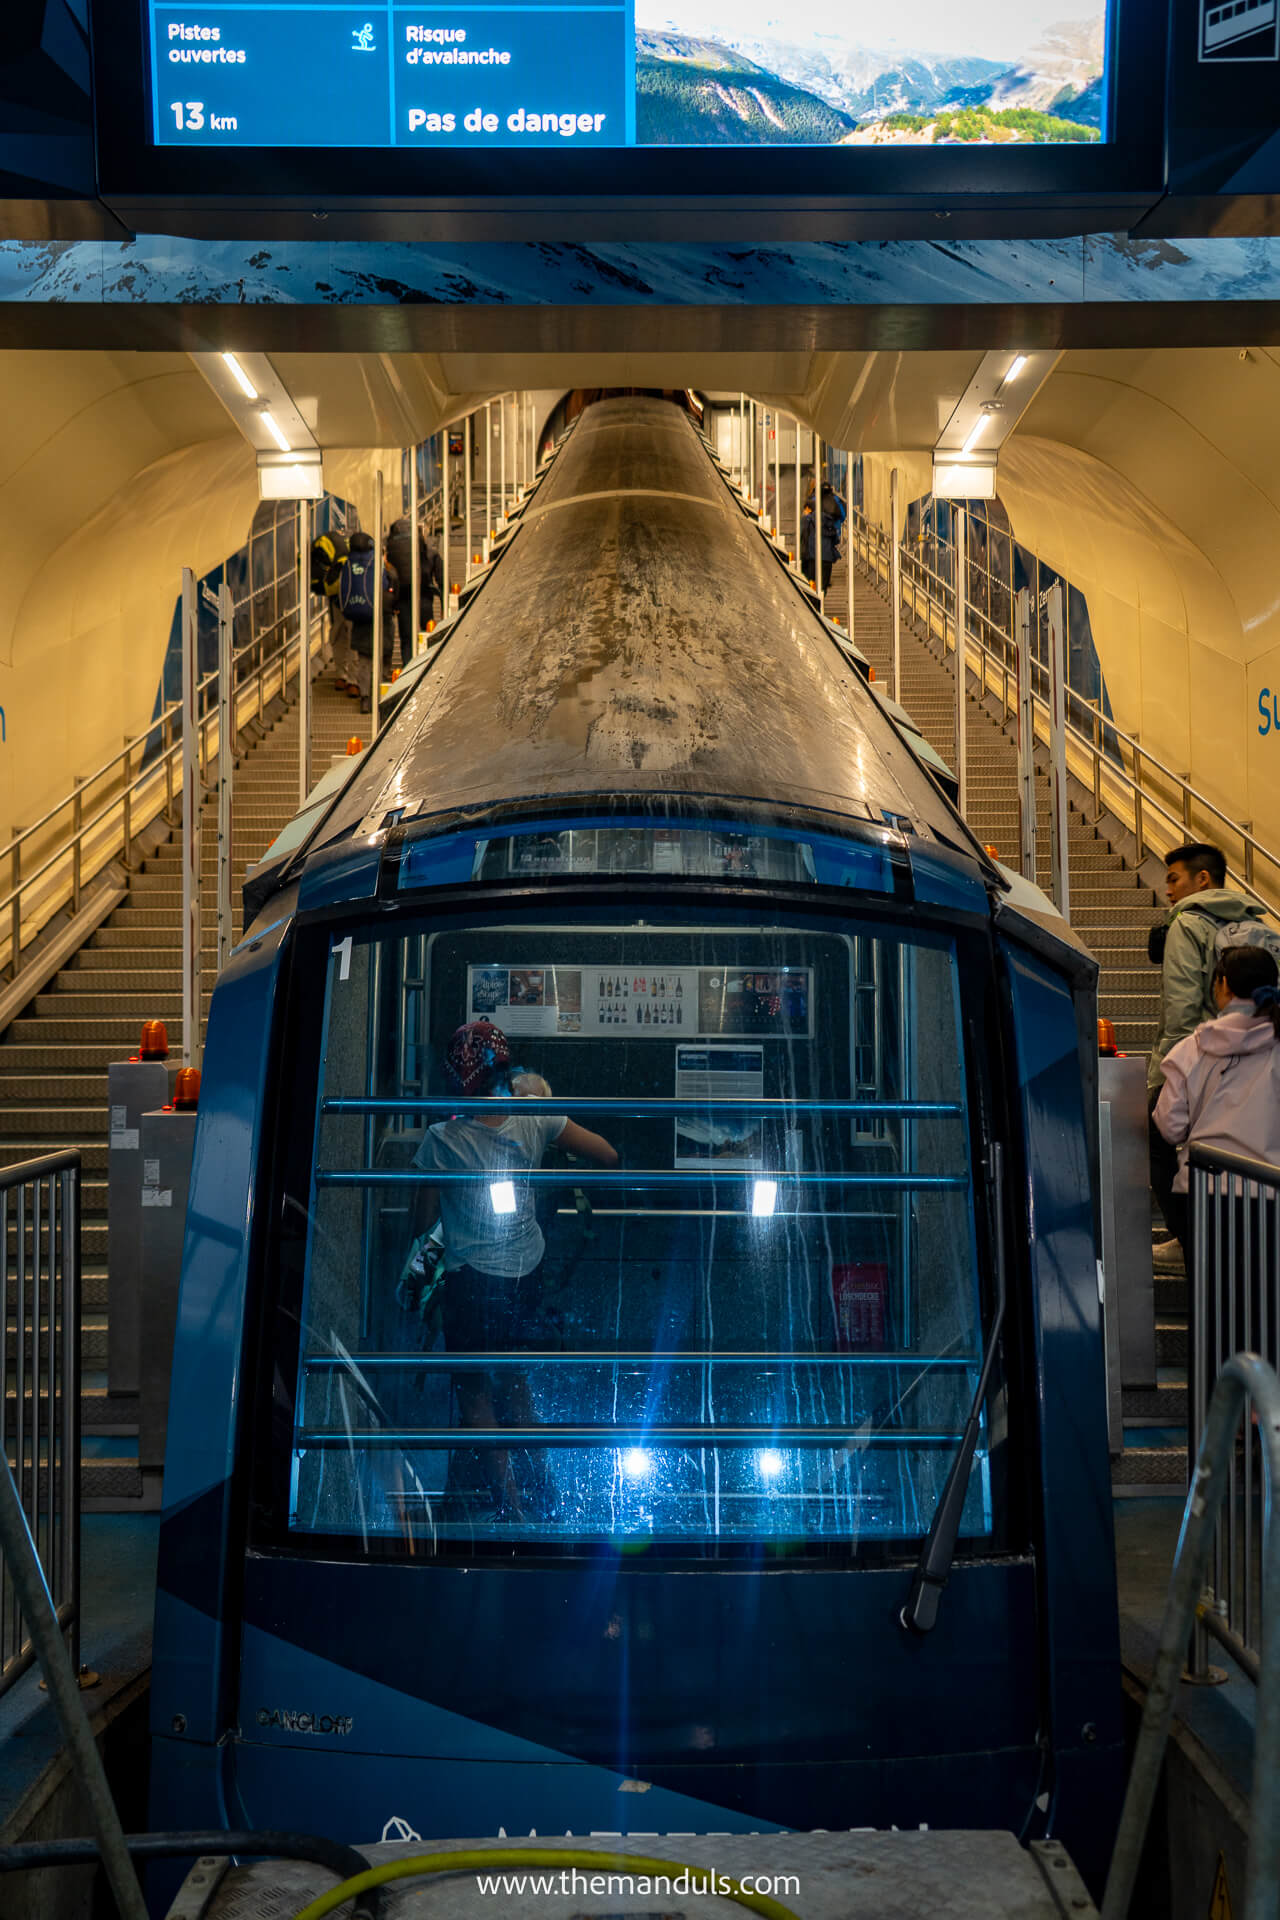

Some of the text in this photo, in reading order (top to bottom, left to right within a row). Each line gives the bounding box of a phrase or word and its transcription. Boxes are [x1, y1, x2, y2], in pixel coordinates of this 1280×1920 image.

[168, 23, 220, 41] Pistes
[406, 25, 466, 45] Risque
[168, 47, 246, 64] ouvertes
[406, 48, 511, 65] d'avalanche
[170, 101, 238, 131] 13 km
[408, 108, 606, 137] Pas de danger
[331, 936, 353, 981] 1
